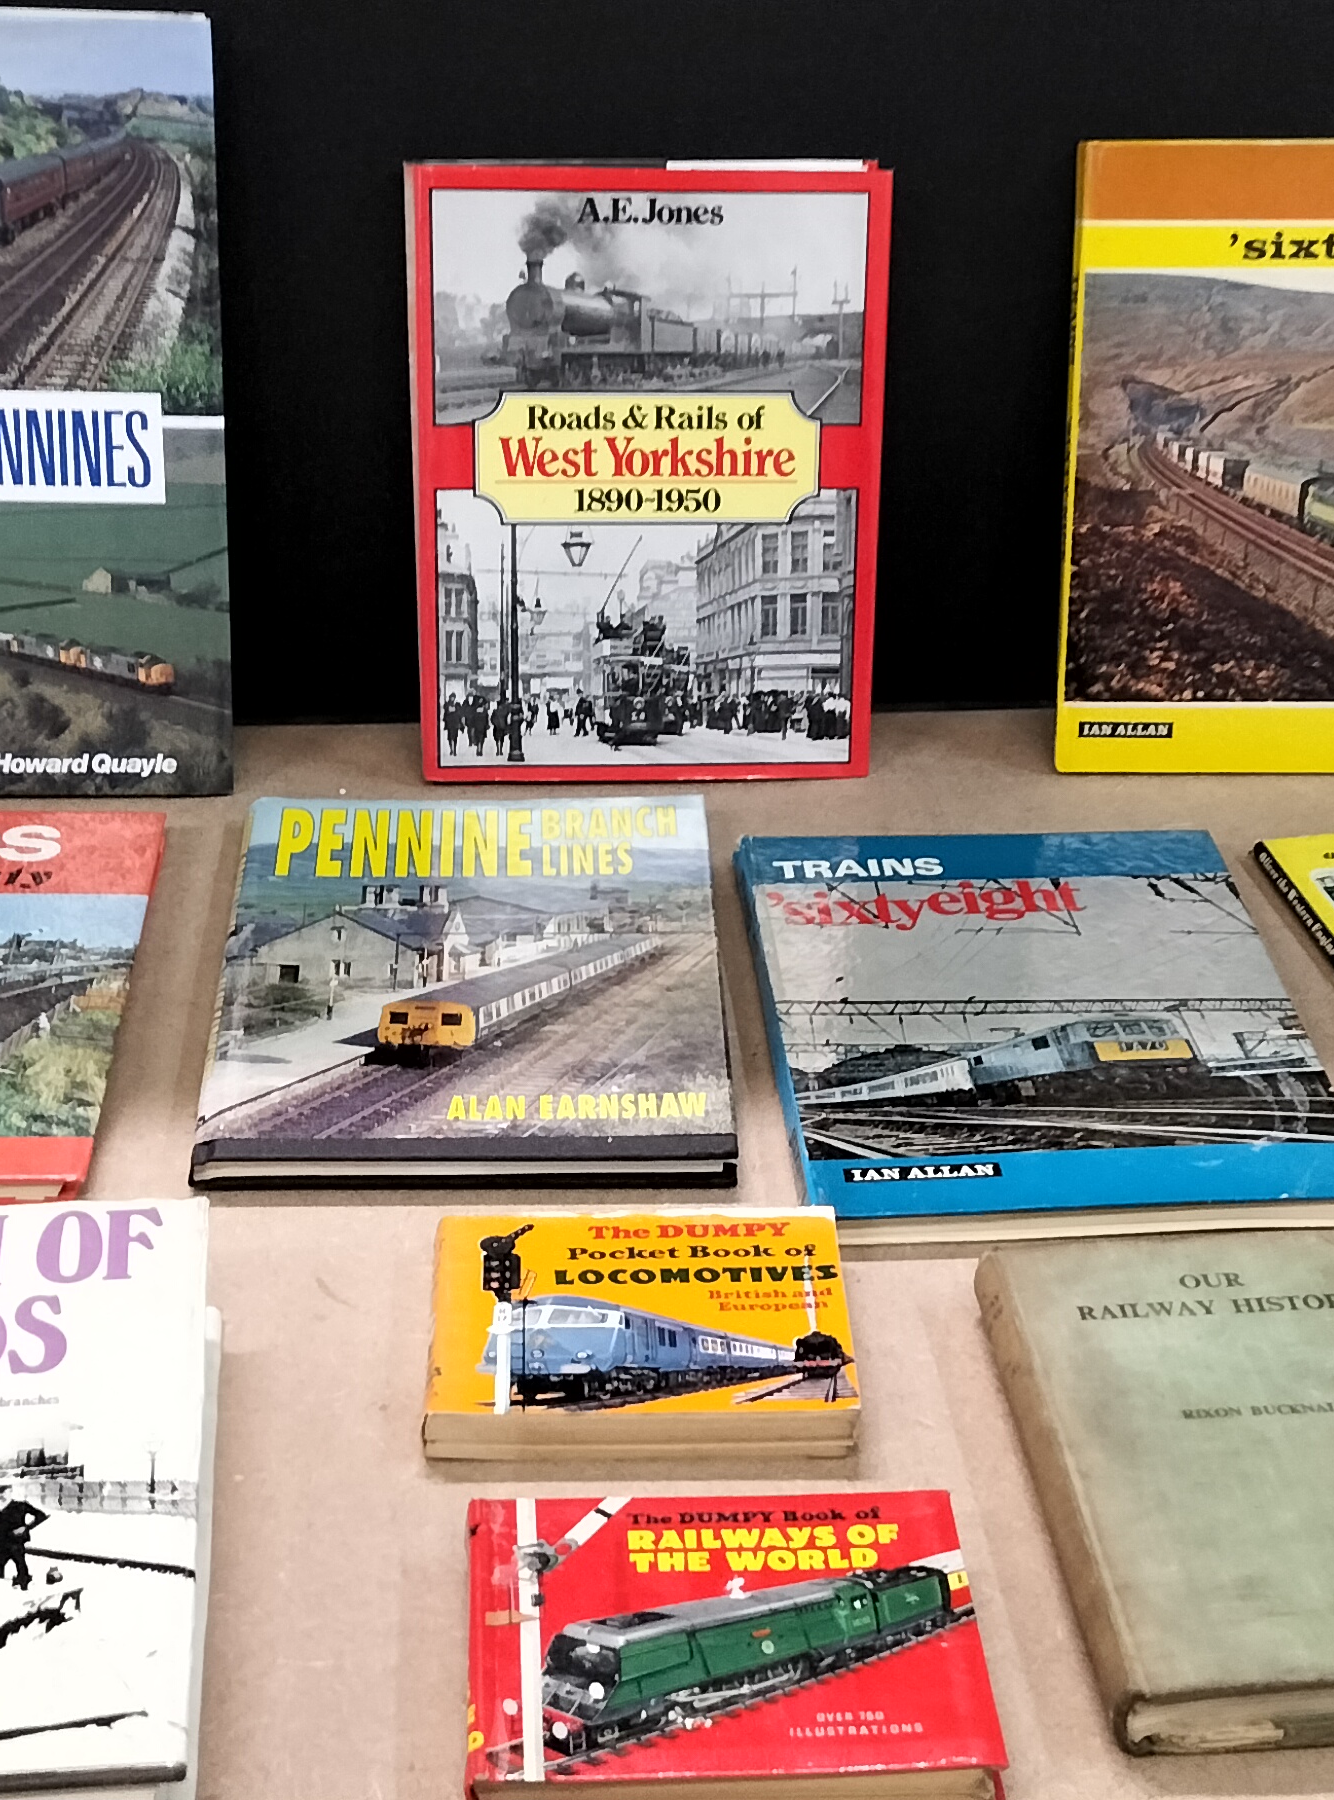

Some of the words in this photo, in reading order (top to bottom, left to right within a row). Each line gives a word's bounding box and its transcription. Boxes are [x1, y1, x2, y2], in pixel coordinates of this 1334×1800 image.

[527, 405, 615, 431] Roads
[622, 405, 648, 431] &
[654, 405, 727, 431] Rails
[737, 404, 765, 431] of
[499, 437, 598, 478] West
[605, 436, 795, 478] Yorkshire
[574, 488, 721, 513] 1890-1950
[1081, 724, 1113, 736] IAN
[1115, 724, 1171, 736] ALLAN
[91, 754, 178, 777] Quayle
[541, 805, 677, 840] BRANCH
[274, 807, 533, 878] PENNINE
[541, 842, 633, 876] LINES
[772, 857, 943, 880] TRAINS
[447, 1095, 526, 1121] ALAN
[540, 1092, 707, 1120] EARNSHAW
[851, 1167, 901, 1182] IAN
[908, 1163, 995, 1179] ALLAN
[588, 1225, 651, 1240] The
[656, 1222, 790, 1239] DUMPY
[36, 1207, 163, 1284] OF
[567, 1245, 679, 1261] Pocket
[687, 1244, 775, 1258] Book
[784, 1244, 816, 1258] of
[554, 1264, 839, 1286] LOCOMOTIVES
[1179, 1272, 1244, 1291] OUR
[708, 1288, 787, 1300] British
[794, 1287, 833, 1299] and
[718, 1301, 829, 1313] European
[1077, 1297, 1216, 1322] RAILWAY
[0, 1394, 60, 1408] branches
[1182, 1405, 1243, 1421] RIXON
[630, 1513, 672, 1525] The
[679, 1511, 773, 1524] DUMPY
[782, 1509, 846, 1522] Book
[855, 1506, 880, 1520] of
[627, 1524, 838, 1551] RAILWAYS
[847, 1523, 898, 1546] OF
[630, 1552, 711, 1573] THE
[725, 1548, 878, 1572] WORLD
[817, 1712, 853, 1722] OVER
[789, 1722, 923, 1737] ILLUSTRATIONS
